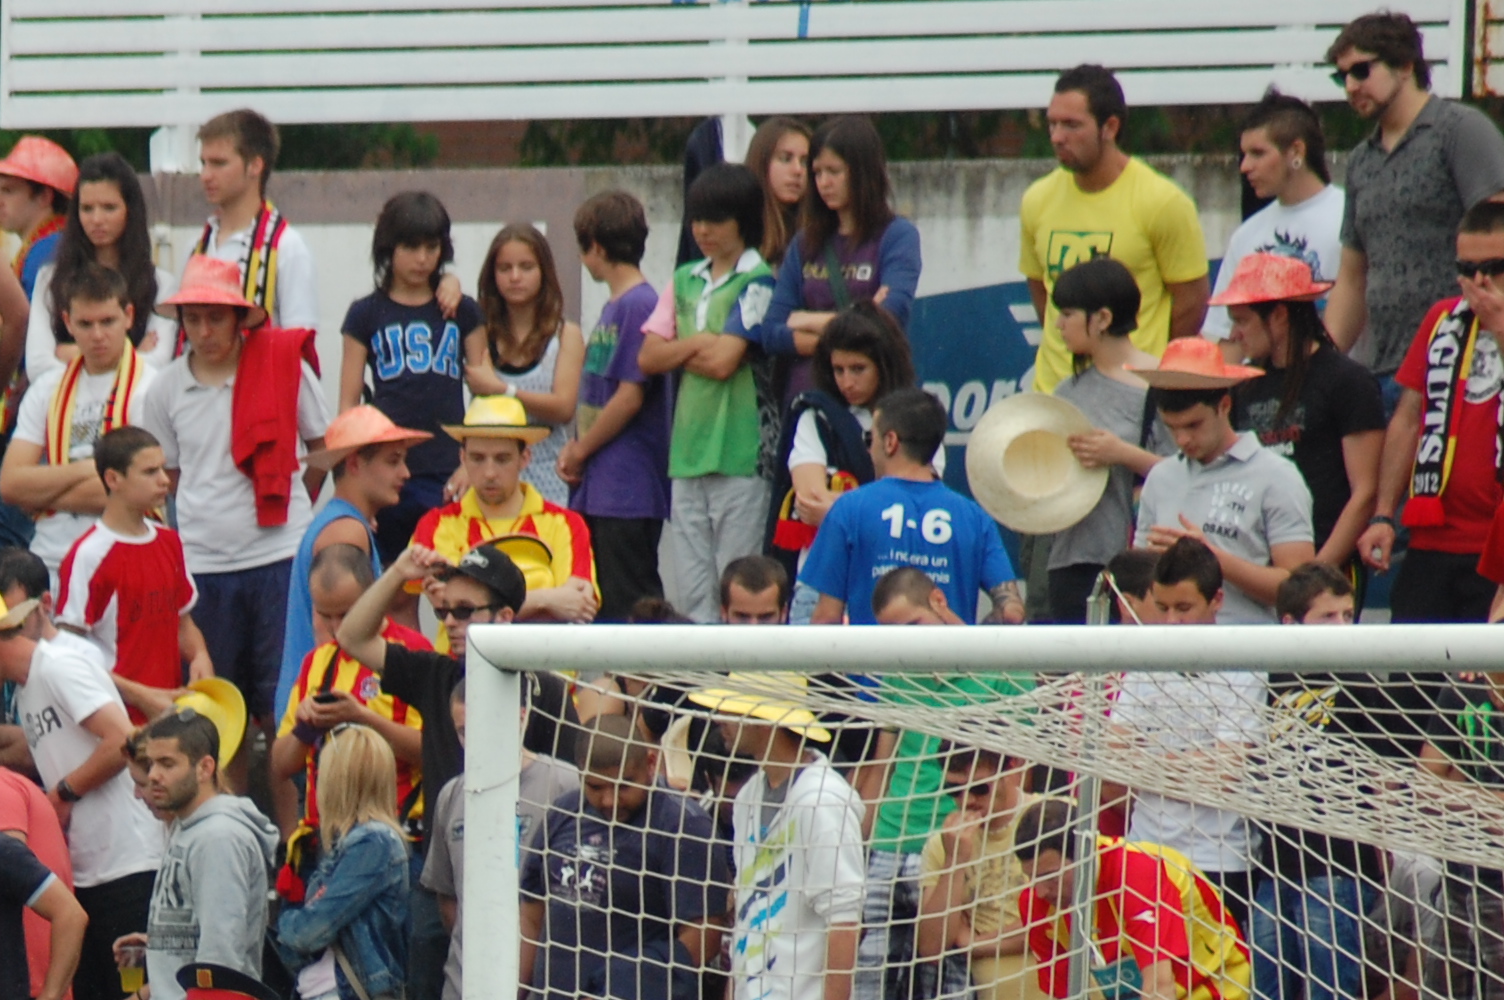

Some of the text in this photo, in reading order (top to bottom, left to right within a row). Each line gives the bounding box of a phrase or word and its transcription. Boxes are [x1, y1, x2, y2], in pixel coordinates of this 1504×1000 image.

[371, 321, 461, 381] USA
[881, 502, 953, 545] 1-6
[1202, 522, 1238, 540] OSAKA
[931, 556, 949, 568] un
